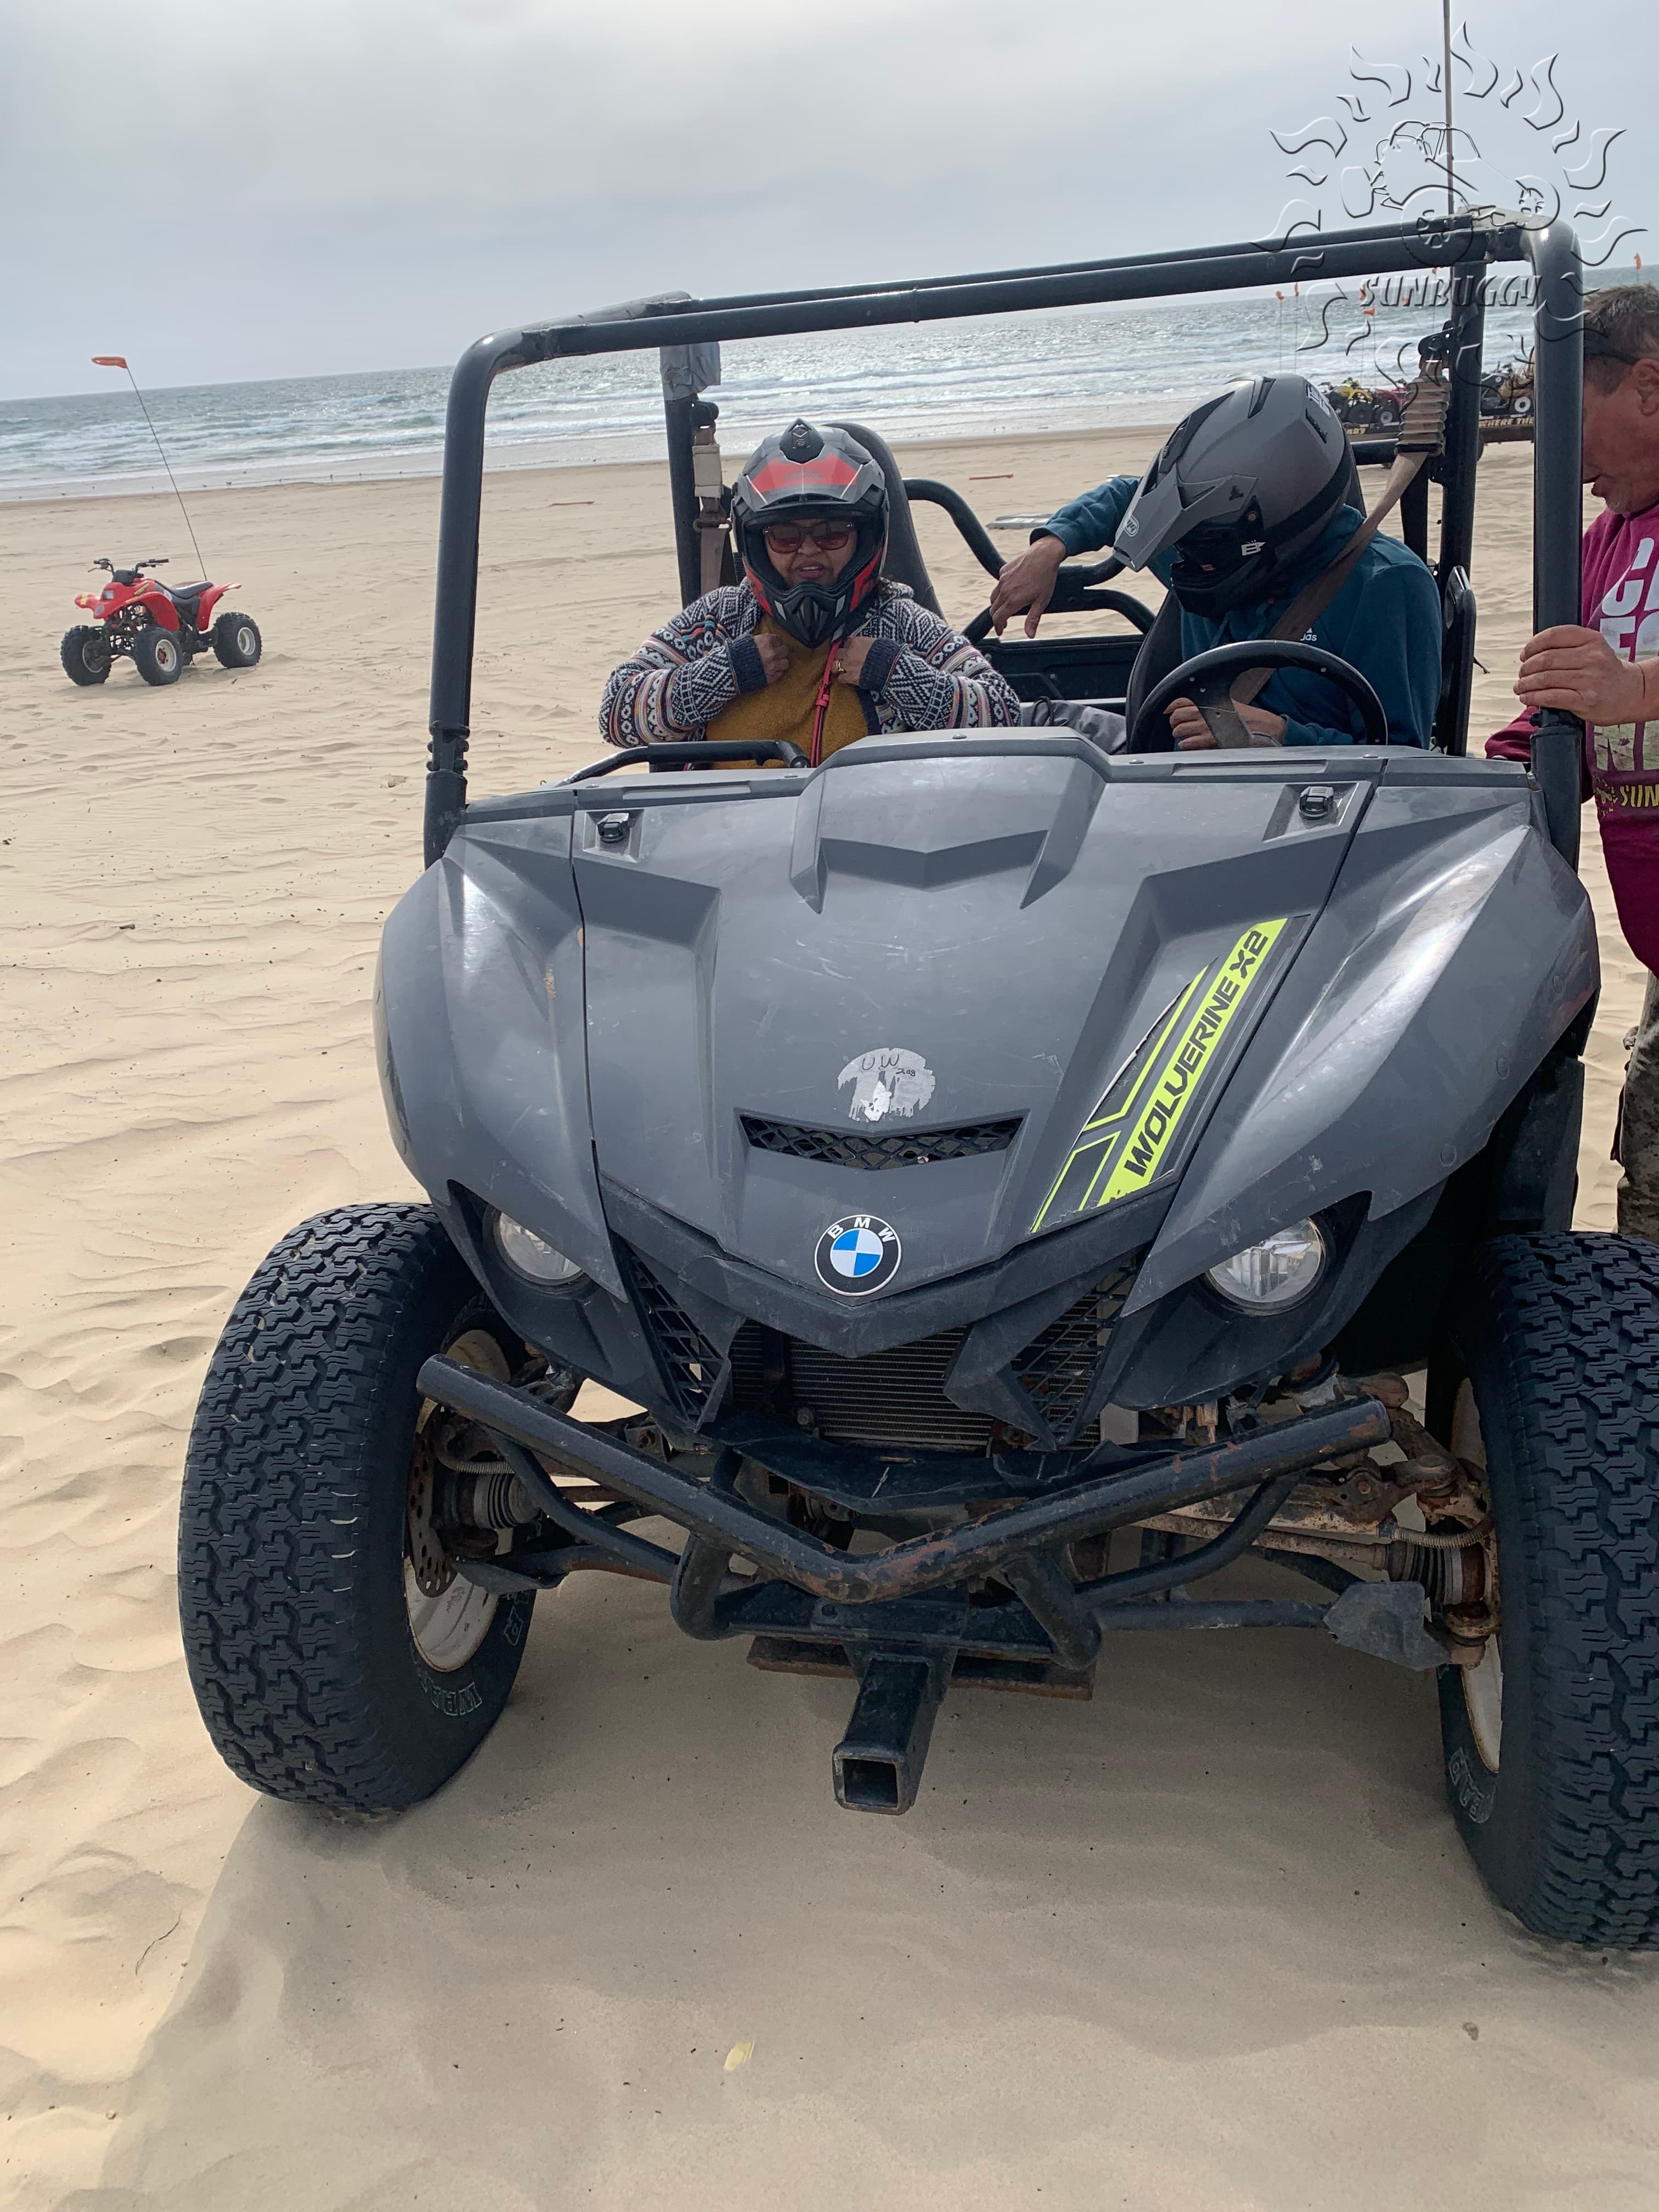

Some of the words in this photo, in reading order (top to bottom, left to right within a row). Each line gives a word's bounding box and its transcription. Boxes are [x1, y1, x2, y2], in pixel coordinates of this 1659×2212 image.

[1124, 977, 1240, 1177] WOLVERINE
[1229, 930, 1269, 979] X2
[827, 1217, 896, 1243] BMW
